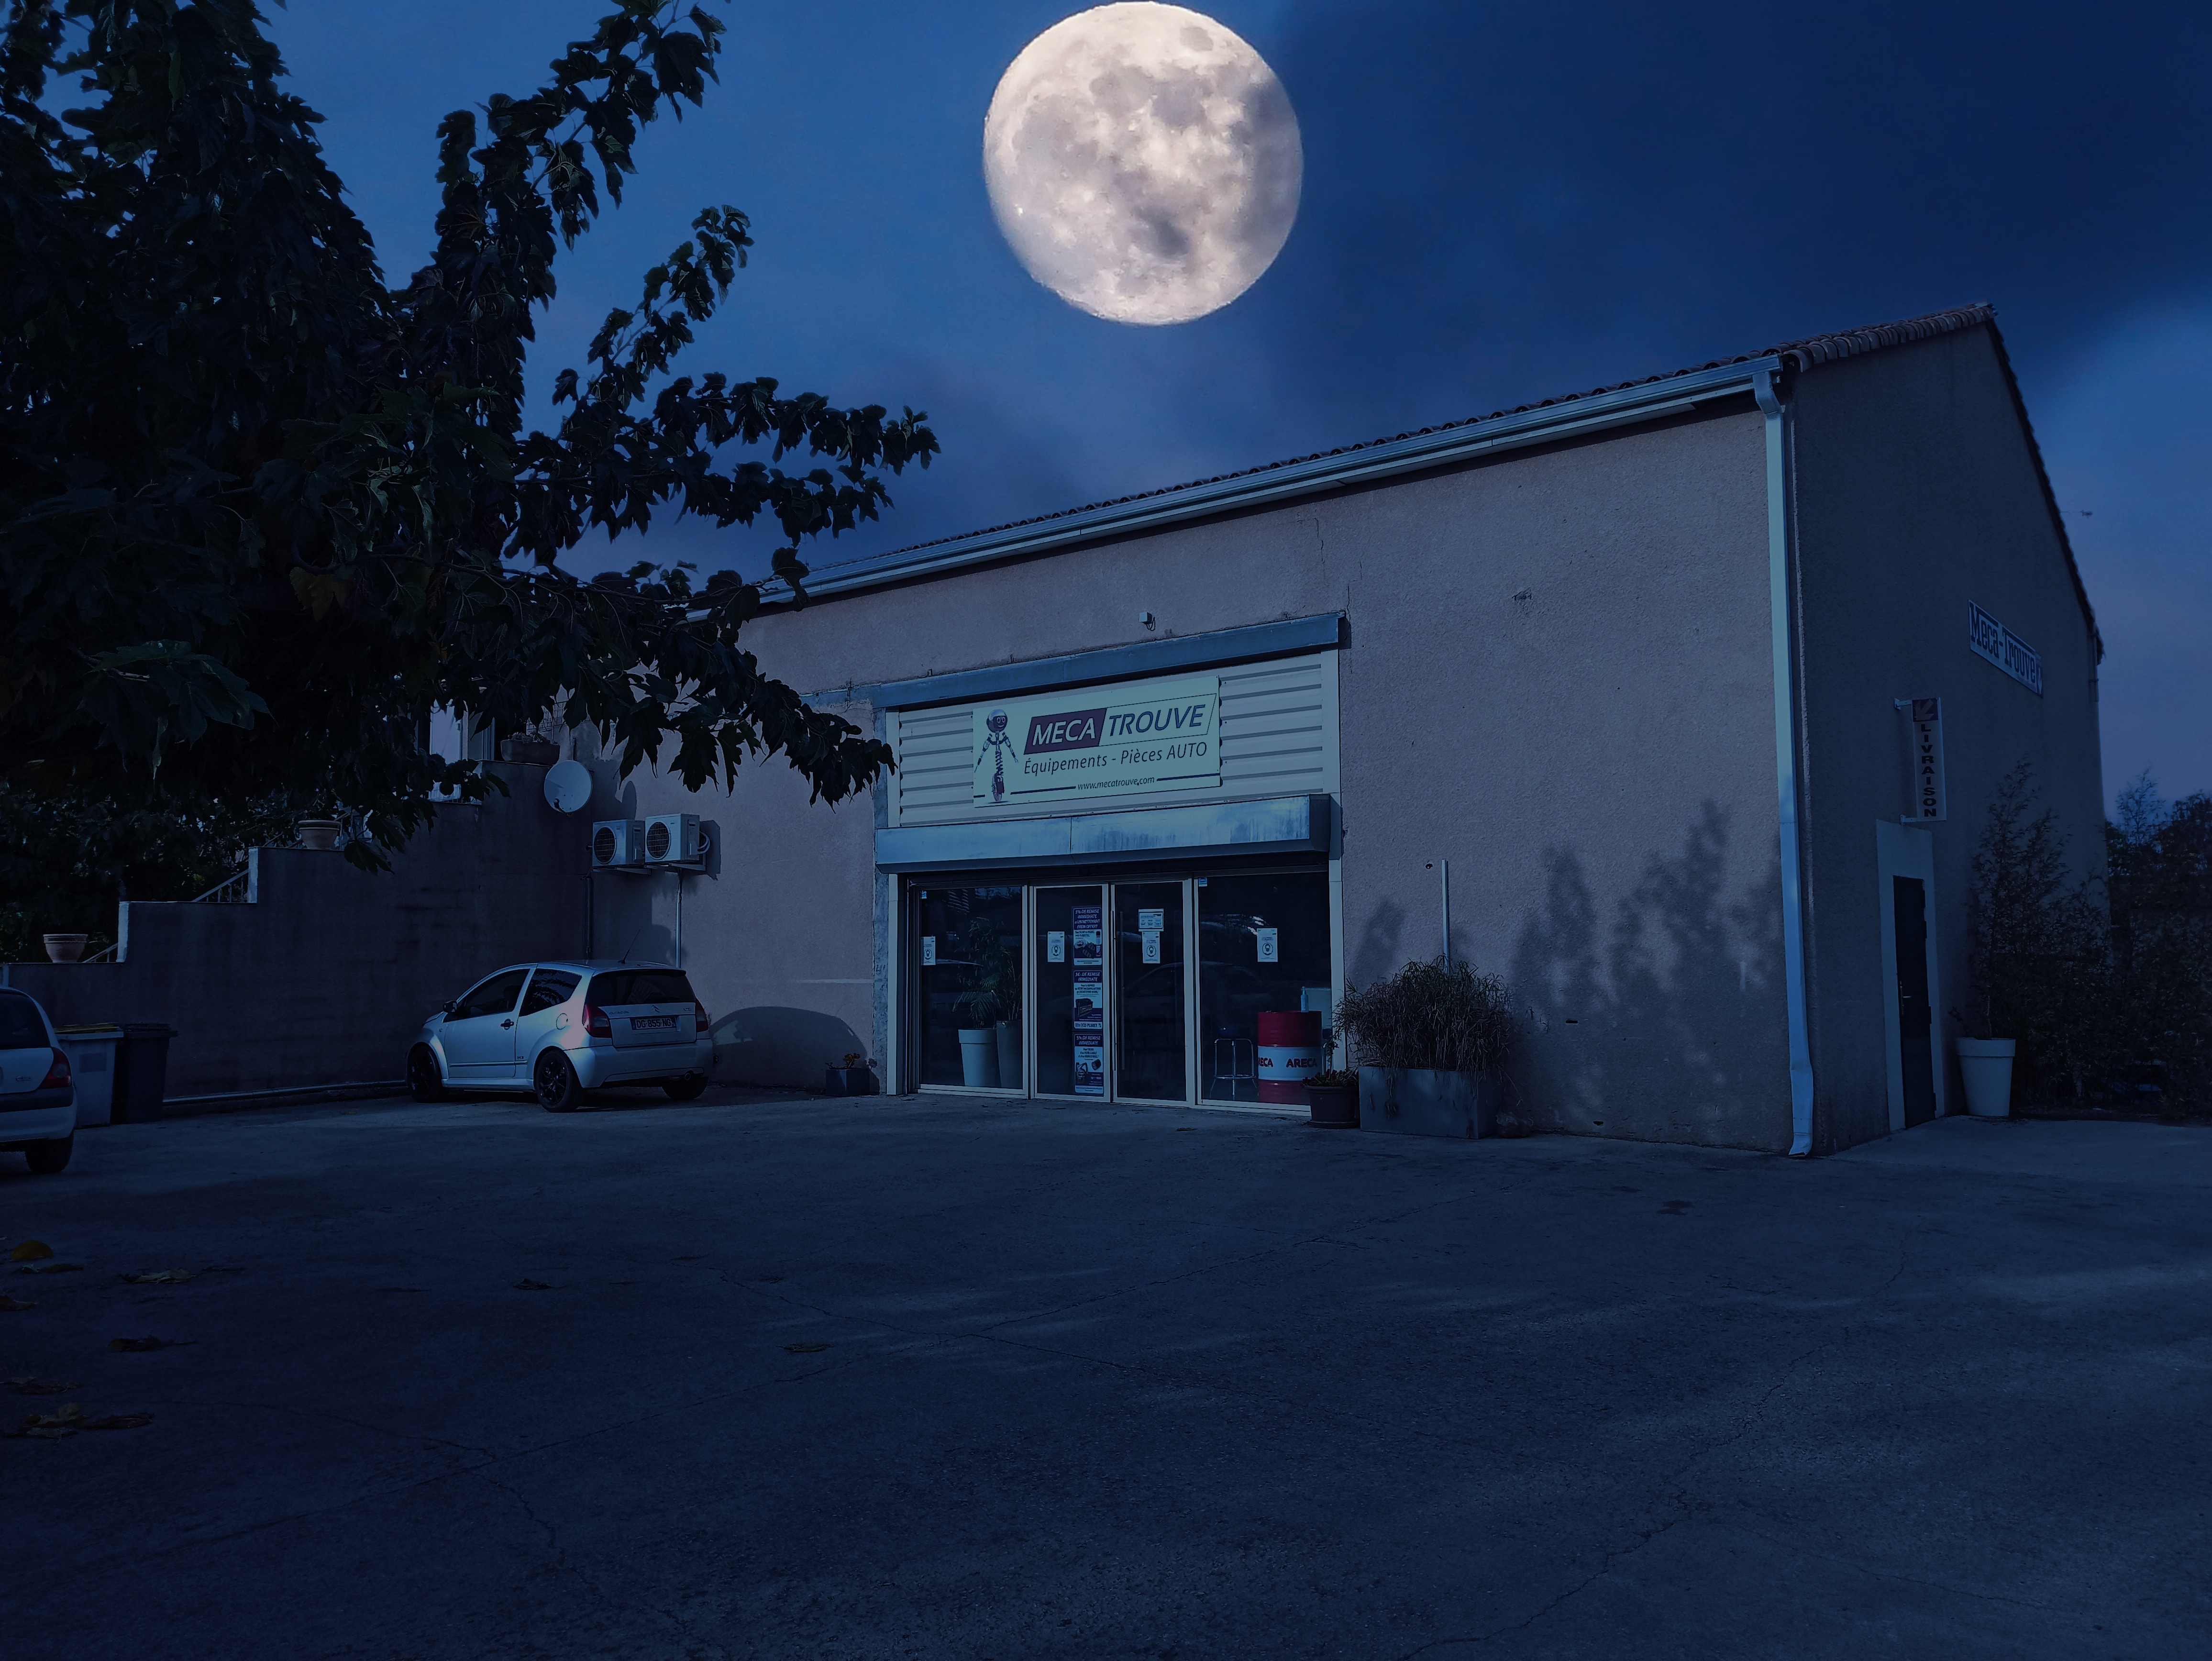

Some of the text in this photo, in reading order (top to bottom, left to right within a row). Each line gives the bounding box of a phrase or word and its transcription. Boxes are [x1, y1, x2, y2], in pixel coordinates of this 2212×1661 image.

[1032, 704, 1206, 746] MECA TROUVE
[1025, 755, 1107, 776] Équipements
[1121, 749, 1162, 764] Pièces
[1166, 742, 1207, 760] AUTO
[1921, 724, 1937, 817] LIVRAISON
[1078, 777, 1155, 790] www.mecatrouve.com
[1286, 1058, 1317, 1068] ARECA
